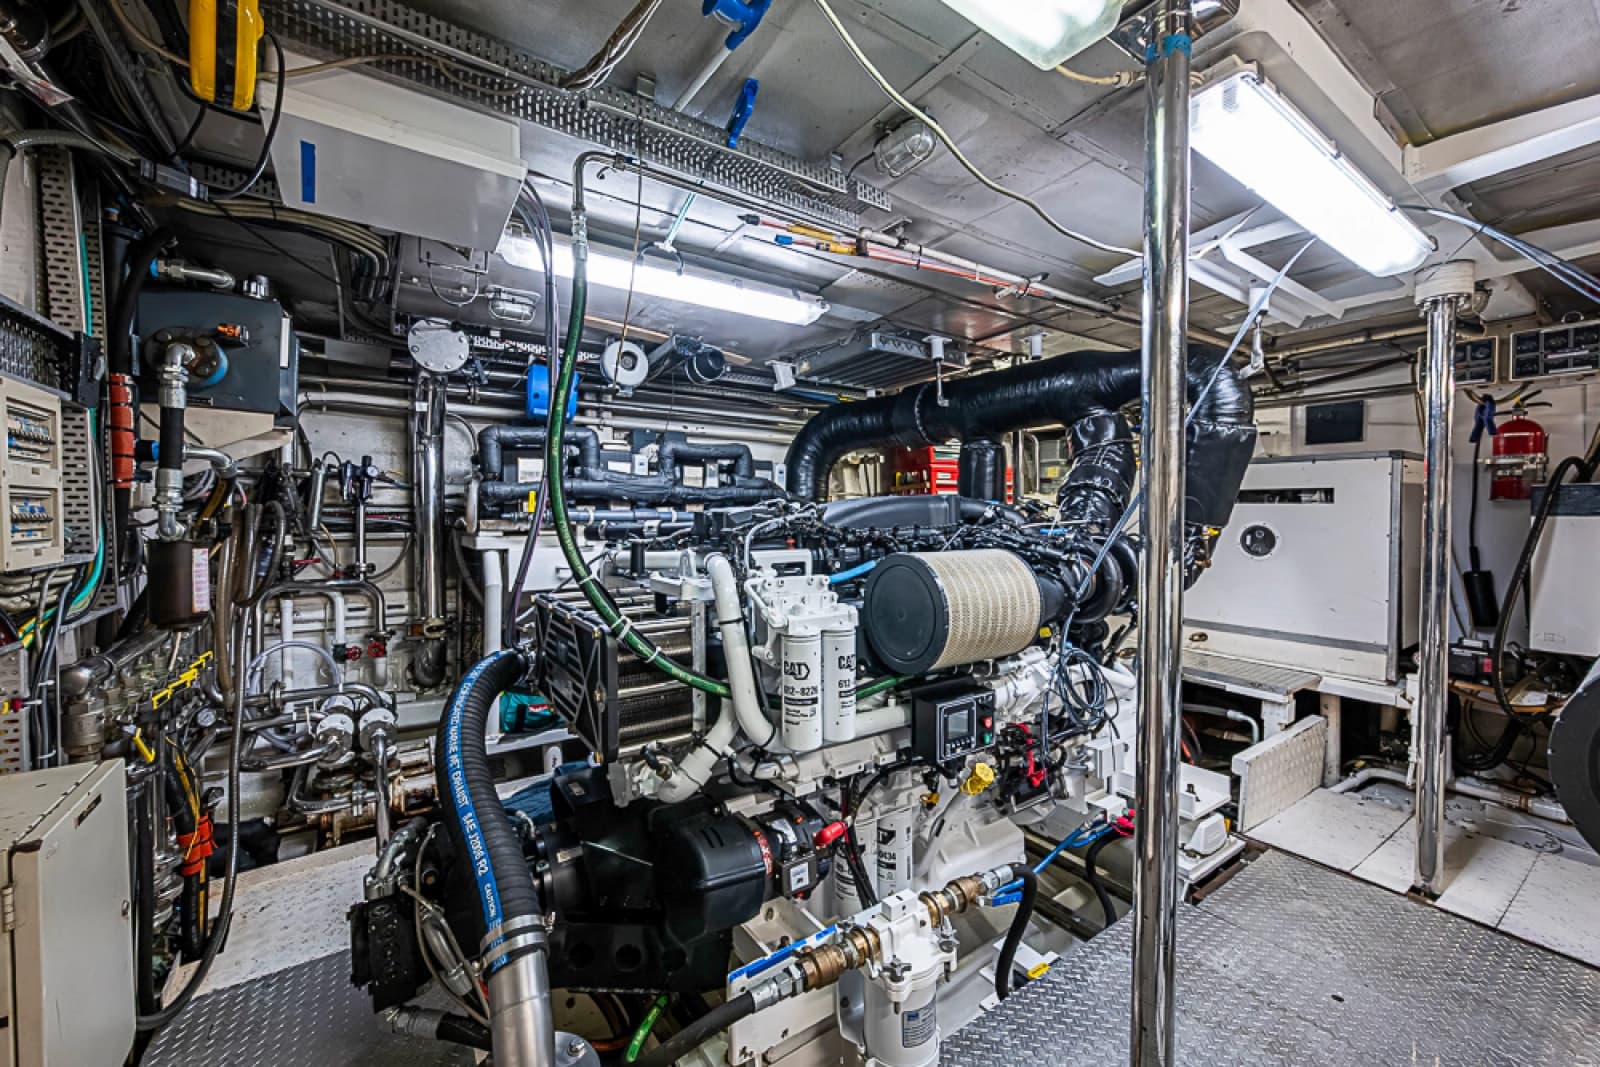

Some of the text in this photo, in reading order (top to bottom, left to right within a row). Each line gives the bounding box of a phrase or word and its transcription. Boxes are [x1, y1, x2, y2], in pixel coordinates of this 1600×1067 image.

[784, 661, 810, 681] CAT
[452, 770, 468, 806] EXHAUST
[462, 812, 476, 832] SAE
[477, 858, 489, 876] R2
[484, 883, 497, 918] CAUTION
